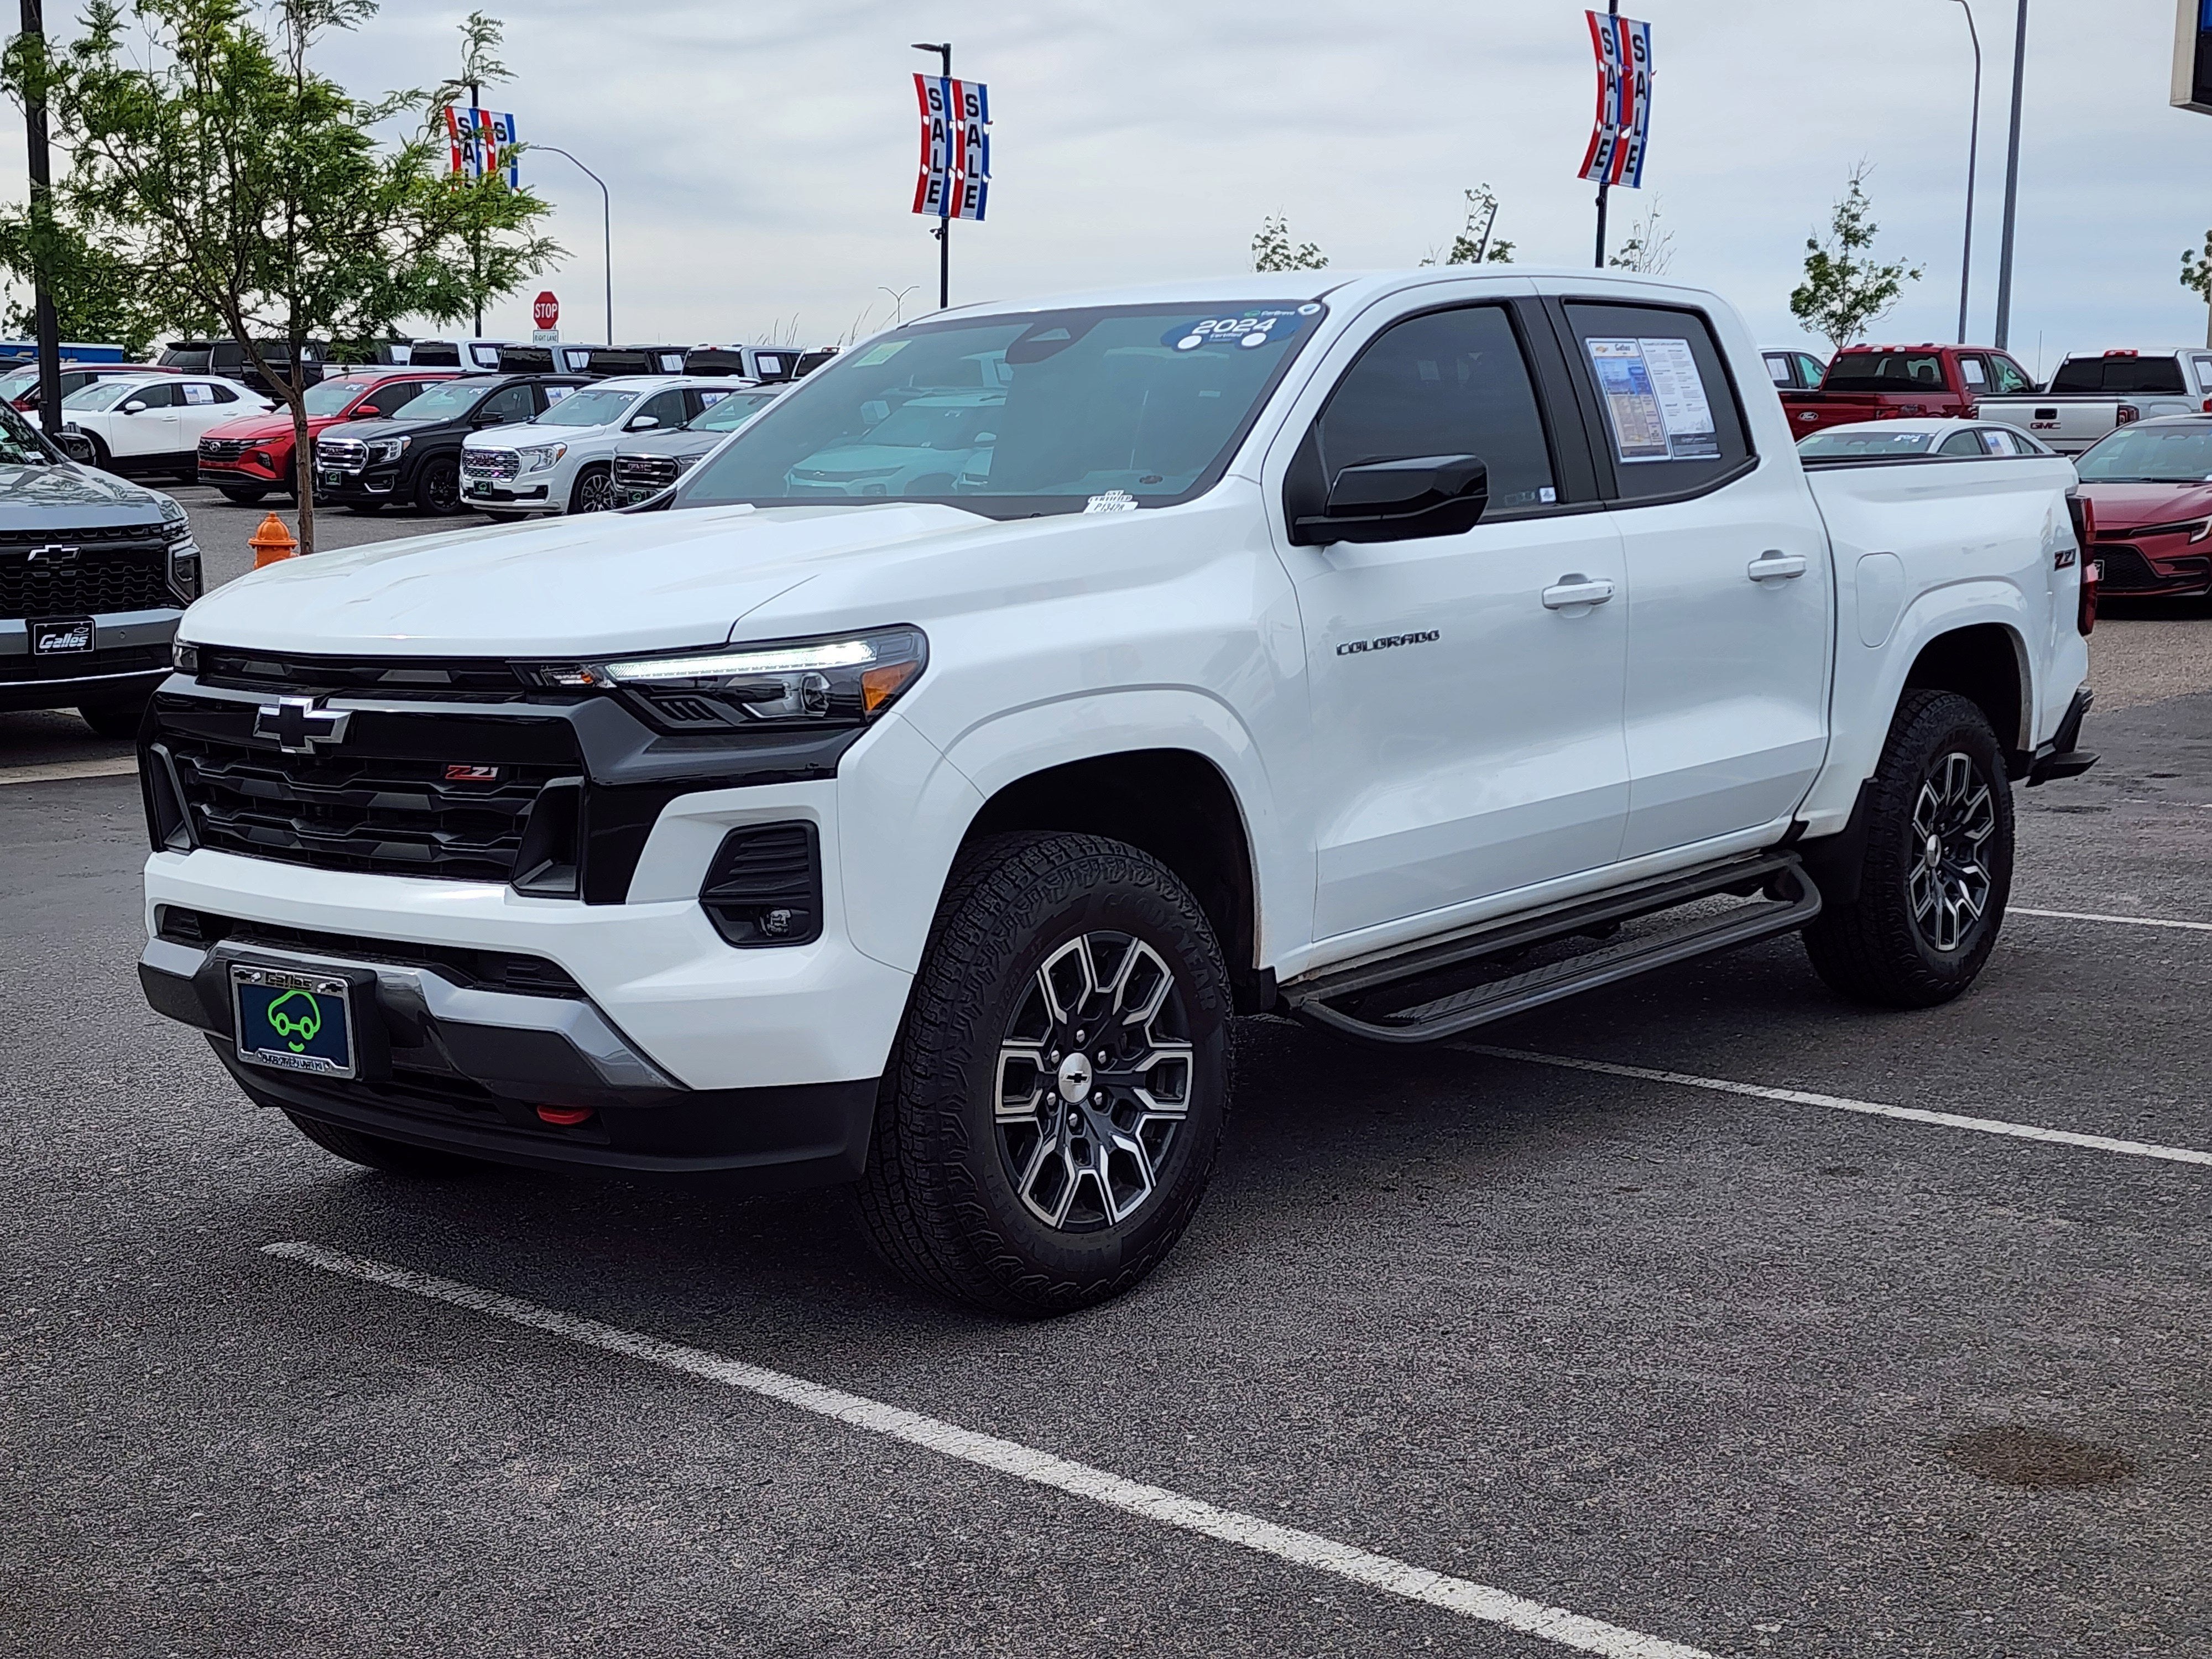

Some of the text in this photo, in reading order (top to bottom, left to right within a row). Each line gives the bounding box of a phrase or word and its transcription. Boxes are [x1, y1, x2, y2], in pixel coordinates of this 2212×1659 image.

[1594, 27, 1617, 168] SALE
[1625, 34, 1646, 173] SALE
[458, 117, 476, 189] SAL
[927, 87, 945, 204] SALE
[964, 93, 982, 208] SALE
[535, 303, 557, 318] STOP
[1192, 318, 1277, 334] 2024
[39, 633, 88, 649] Galles
[1337, 629, 1440, 656] COLORADO
[445, 765, 499, 781] Z71
